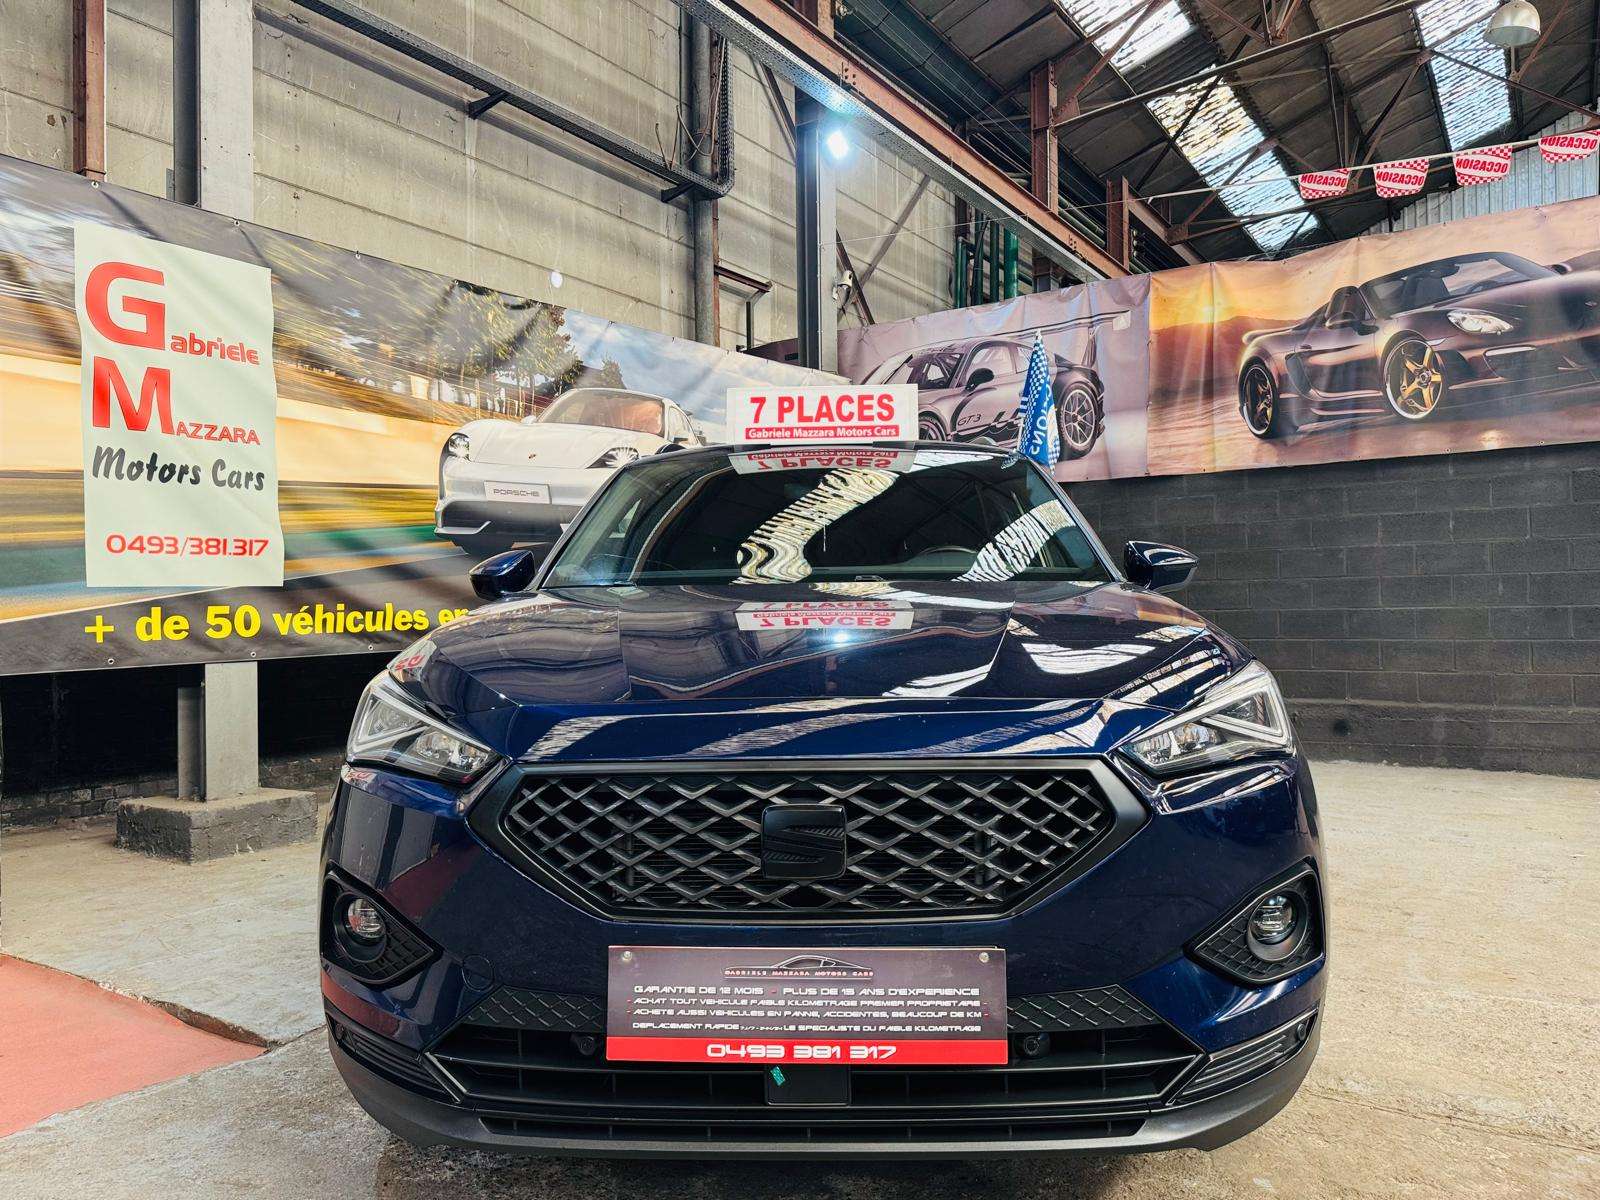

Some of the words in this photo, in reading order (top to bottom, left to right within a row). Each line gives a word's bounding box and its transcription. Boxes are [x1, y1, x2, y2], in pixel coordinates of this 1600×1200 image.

[750, 396, 766, 424] 7
[778, 394, 895, 424] PLACES
[749, 428, 791, 438] Gabriele
[793, 428, 834, 438] Mazzara
[836, 427, 872, 437] Motors
[874, 426, 896, 436] Cars
[92, 445, 201, 485] Motors
[211, 458, 265, 491] Cars
[493, 488, 540, 497] PORSCHE
[106, 534, 269, 557] 0493/381.317
[135, 606, 190, 642] de
[205, 604, 261, 639] 50
[272, 602, 430, 635] véhicules
[634, 986, 696, 994] GARANTIE
[699, 986, 716, 994] DE
[720, 986, 731, 994] 12
[734, 987, 764, 995] MOIS
[783, 988, 818, 996] PLUS
[820, 988, 838, 996] DE
[841, 988, 855, 996] 15
[858, 988, 885, 996] ANS
[888, 988, 980, 996] D'EXPERIENCE
[787, 999, 858, 1007] KILOMETRAGE
[710, 1009, 765, 1017] VEHICULES
[706, 1043, 785, 1059] 0493
[793, 1044, 841, 1059] 381
[849, 1045, 897, 1060] 317
